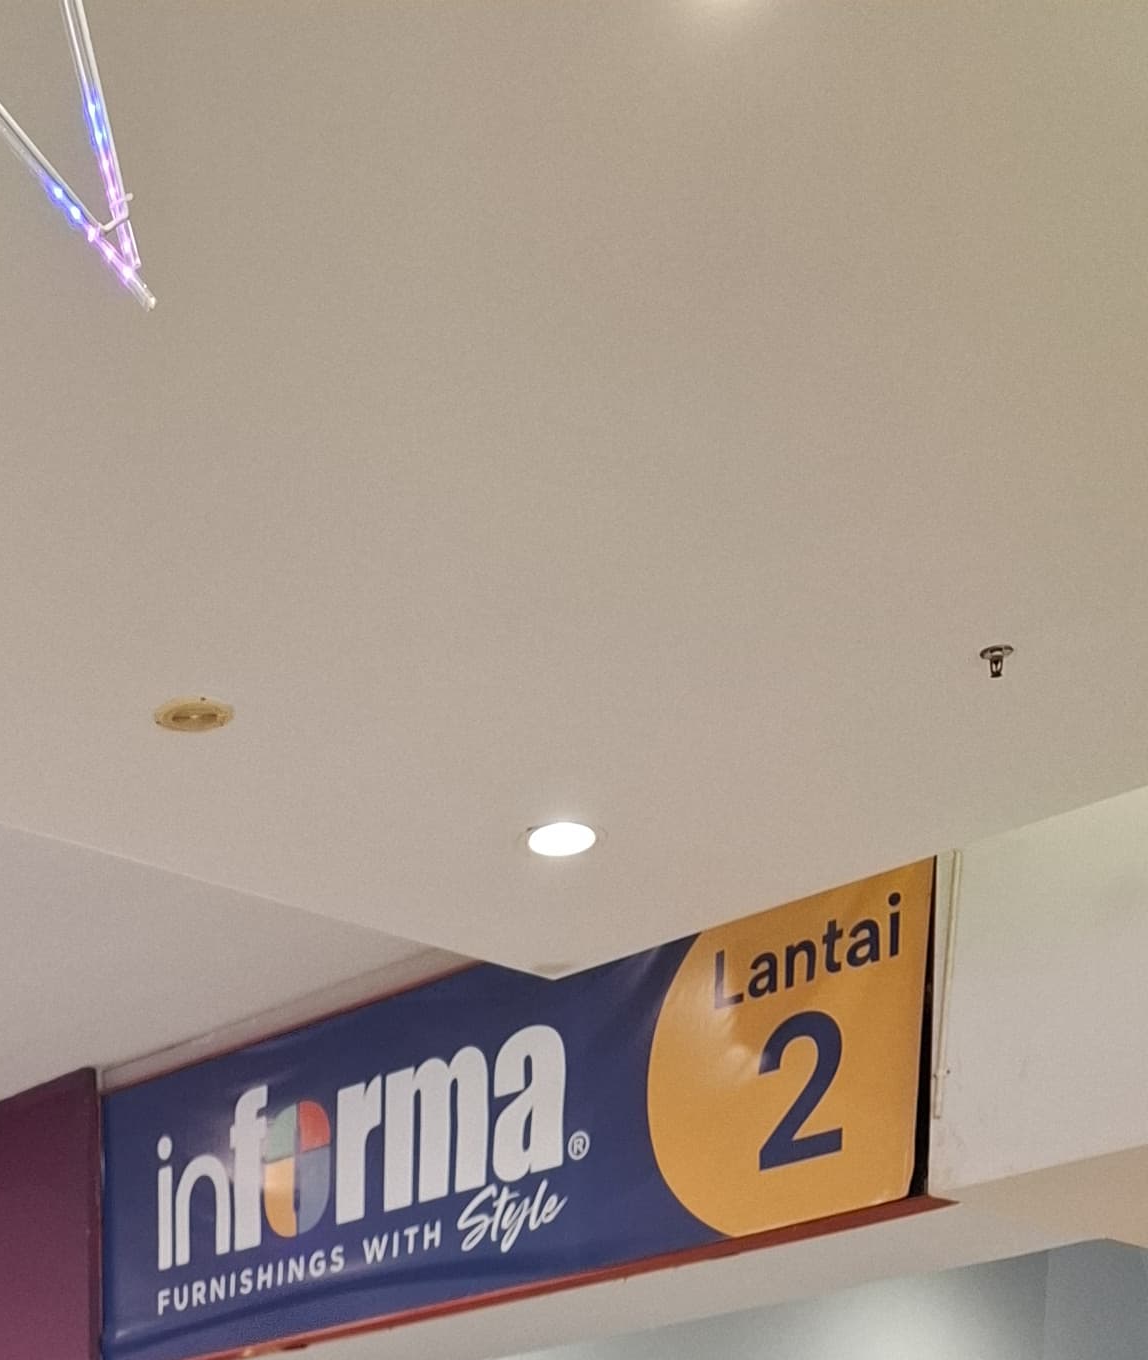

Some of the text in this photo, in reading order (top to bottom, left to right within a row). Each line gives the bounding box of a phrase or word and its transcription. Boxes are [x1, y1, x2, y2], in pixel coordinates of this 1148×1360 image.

[713, 892, 902, 1010] Lantai
[156, 1024, 569, 1272] informa
[757, 1010, 844, 1172] 2
[156, 1178, 569, 1316] FURNISHINGS WITH Style
